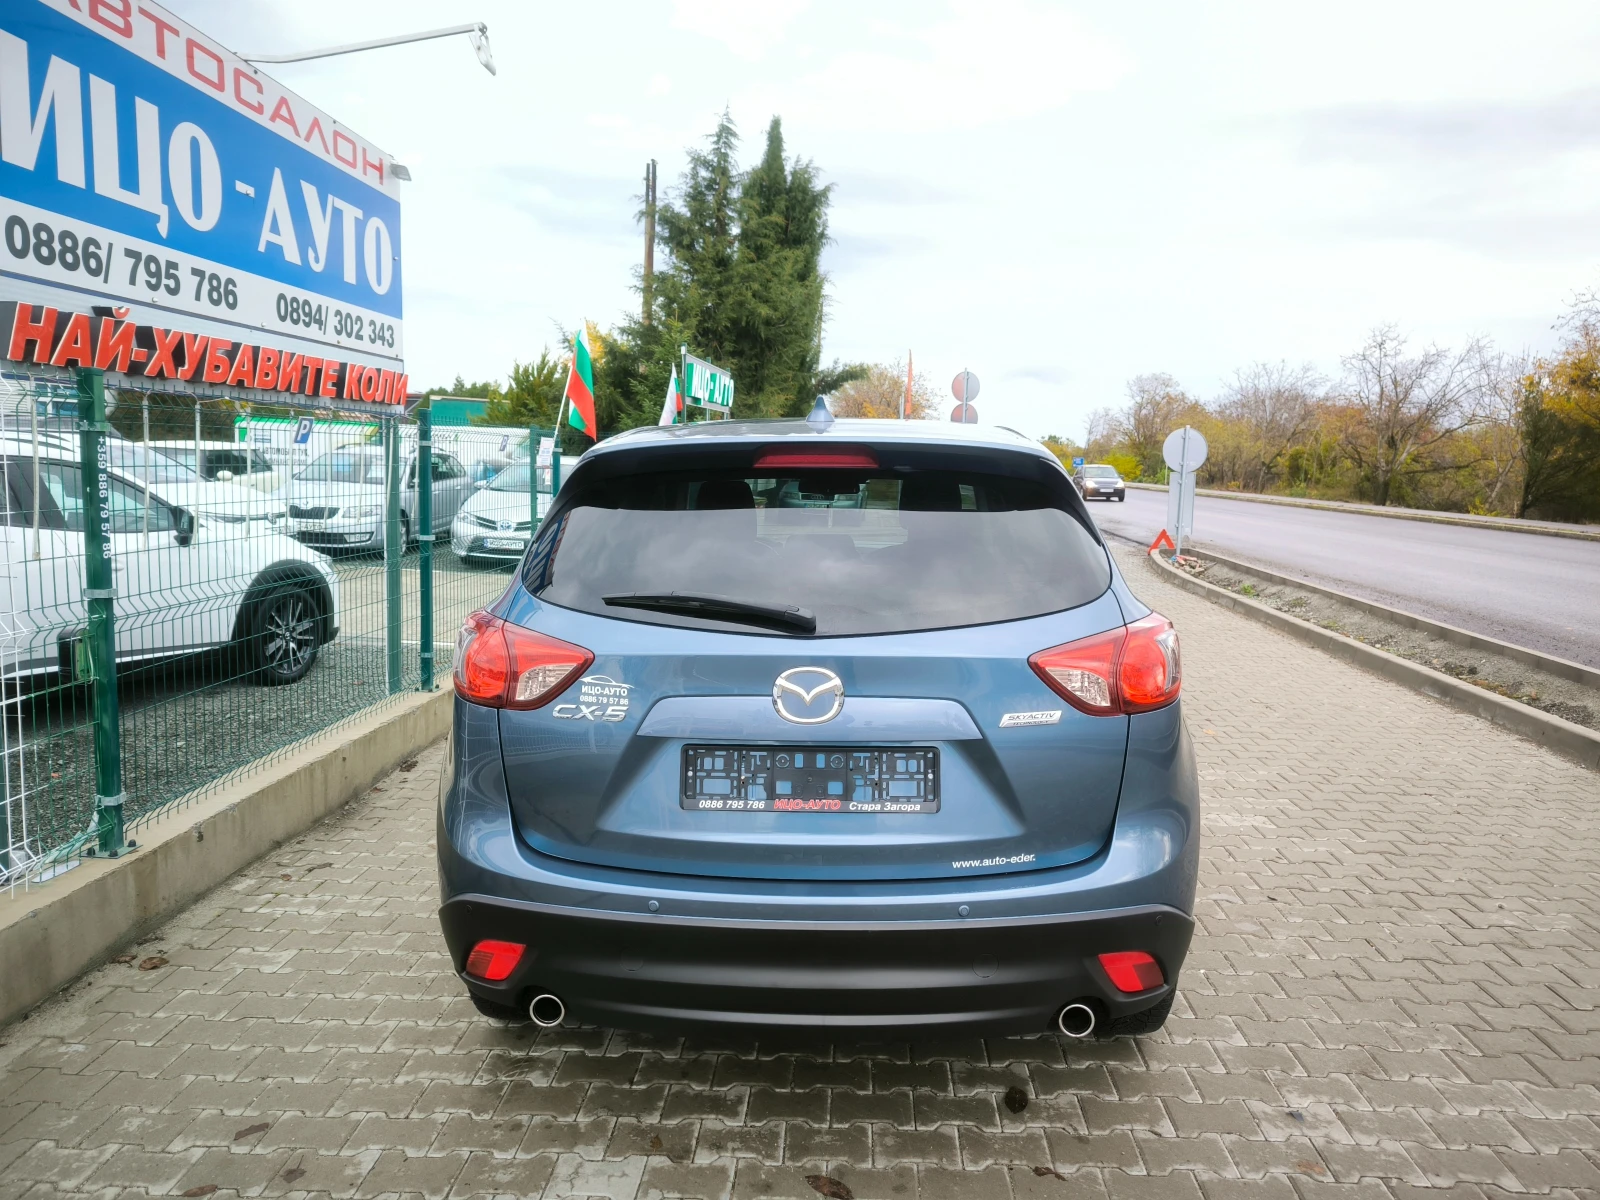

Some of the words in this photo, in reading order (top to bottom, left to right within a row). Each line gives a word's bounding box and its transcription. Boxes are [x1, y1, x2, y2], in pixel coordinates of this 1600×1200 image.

[68, 0, 384, 186] ВТОСАЛОН
[4, 215, 114, 284] 0886/
[124, 248, 181, 297] 795
[190, 267, 239, 311] 786
[276, 293, 330, 336] 0894/
[334, 309, 364, 341] 302
[368, 319, 395, 348] 343
[7, 302, 340, 399] НАЙ-ХУБАВИТЕ
[343, 362, 409, 406] КОЛИ
[691, 363, 734, 408] ИЦО-АУТО
[97, 436, 106, 469] +359
[98, 473, 107, 497] 886
[100, 501, 108, 518] 79
[101, 523, 110, 537] 57
[102, 542, 111, 559] 86
[581, 685, 628, 697] ИЦО-АУТО
[580, 695, 597, 703] 0886
[598, 696, 607, 704] 79
[609, 697, 618, 705] 57
[619, 698, 629, 706] 86
[552, 704, 629, 722] CX-5
[1008, 712, 1057, 721] SKYACTIV
[698, 799, 724, 809] 0886
[725, 800, 745, 809] 795
[746, 800, 766, 810] 786
[773, 798, 842, 811] ИЦО-АУТО
[849, 801, 881, 812] Стара
[883, 802, 921, 812] Загора
[952, 853, 1036, 869] www.auto-eder.
